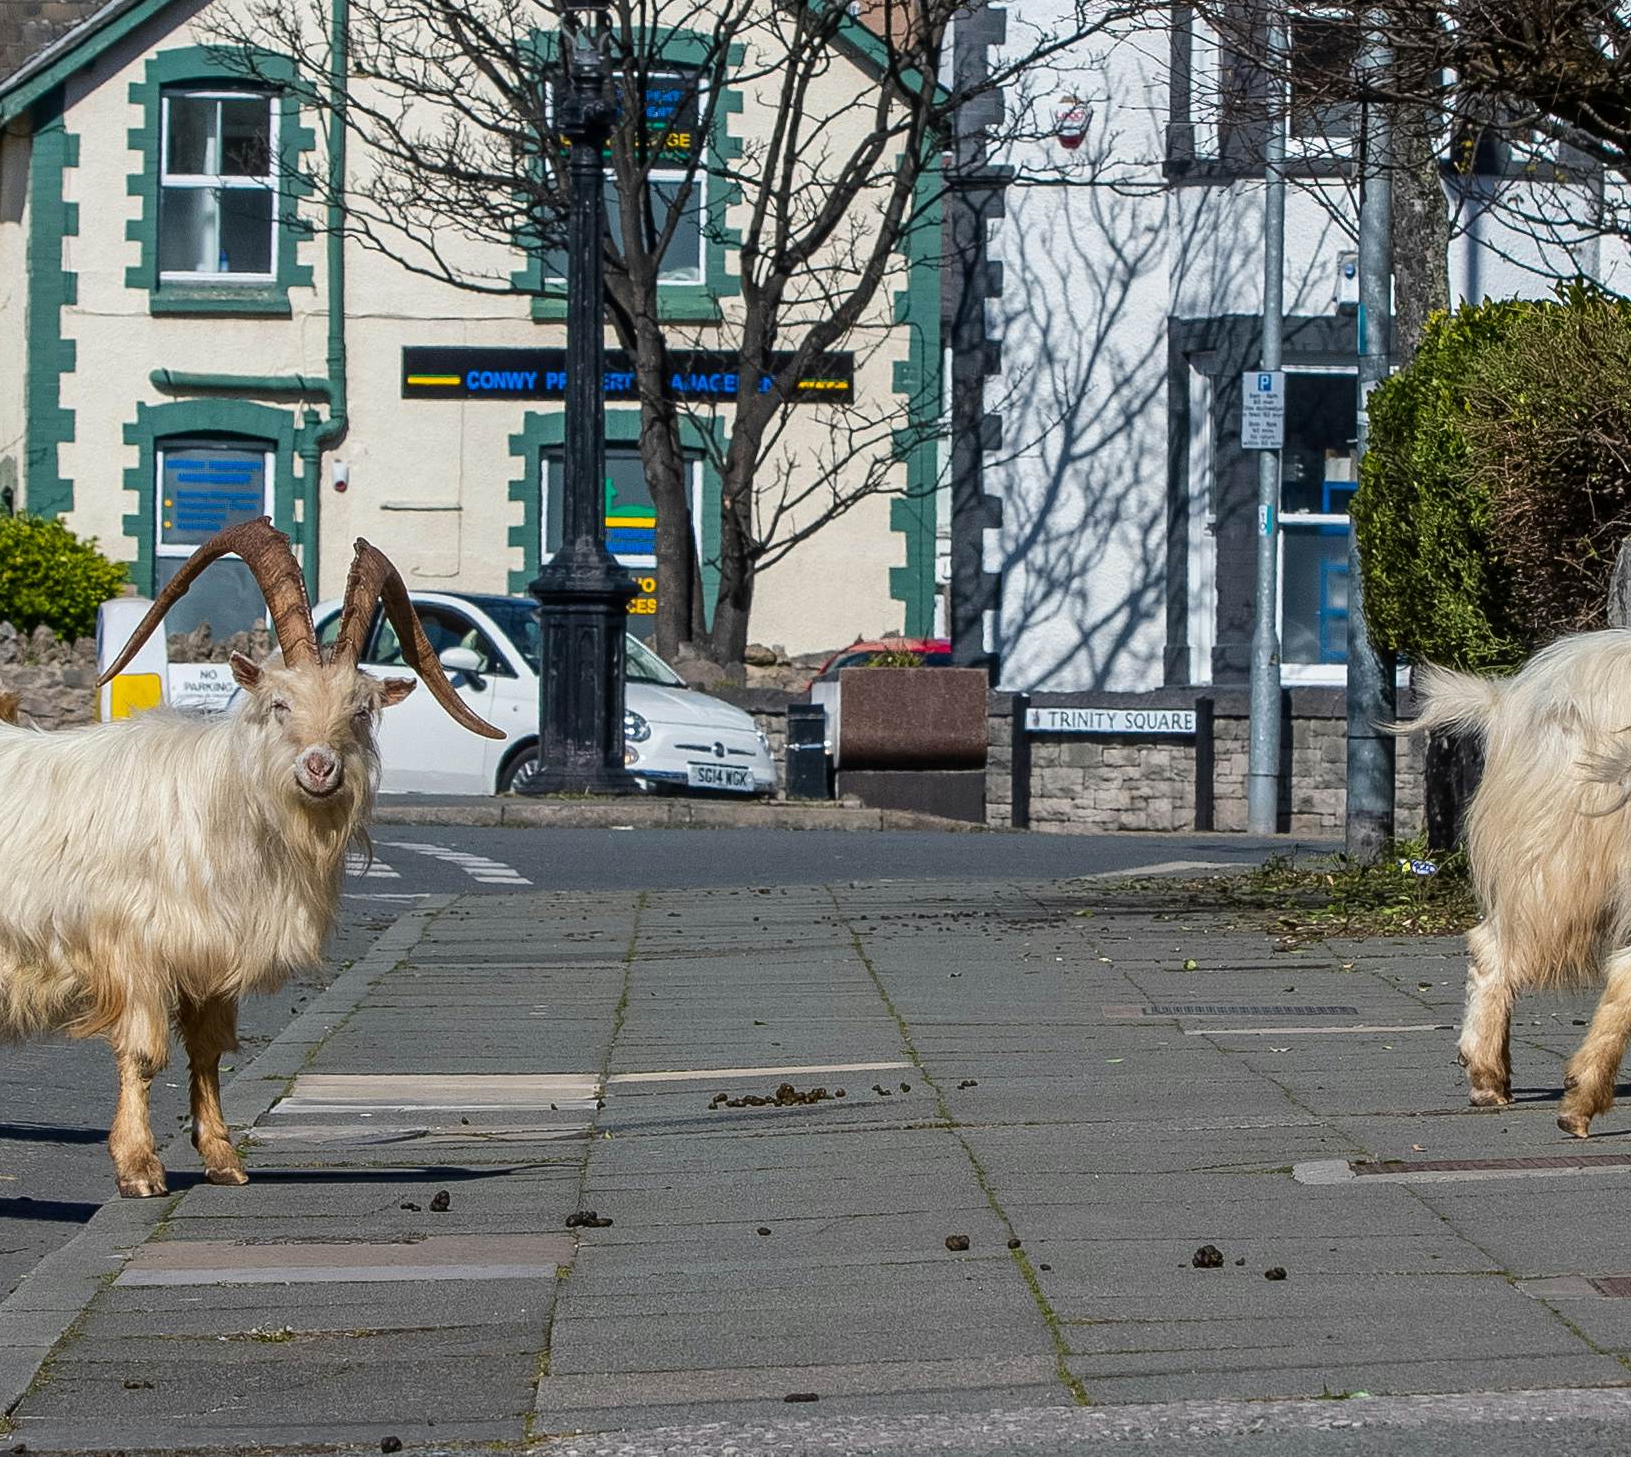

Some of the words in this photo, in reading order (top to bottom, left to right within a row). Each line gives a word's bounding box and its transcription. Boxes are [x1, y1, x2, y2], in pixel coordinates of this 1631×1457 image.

[466, 370, 537, 390] CONWY
[200, 669, 217, 680] NO
[184, 682, 233, 692] PARKING
[1048, 711, 1117, 729] TRINITY
[1125, 712, 1193, 730] SQUARE
